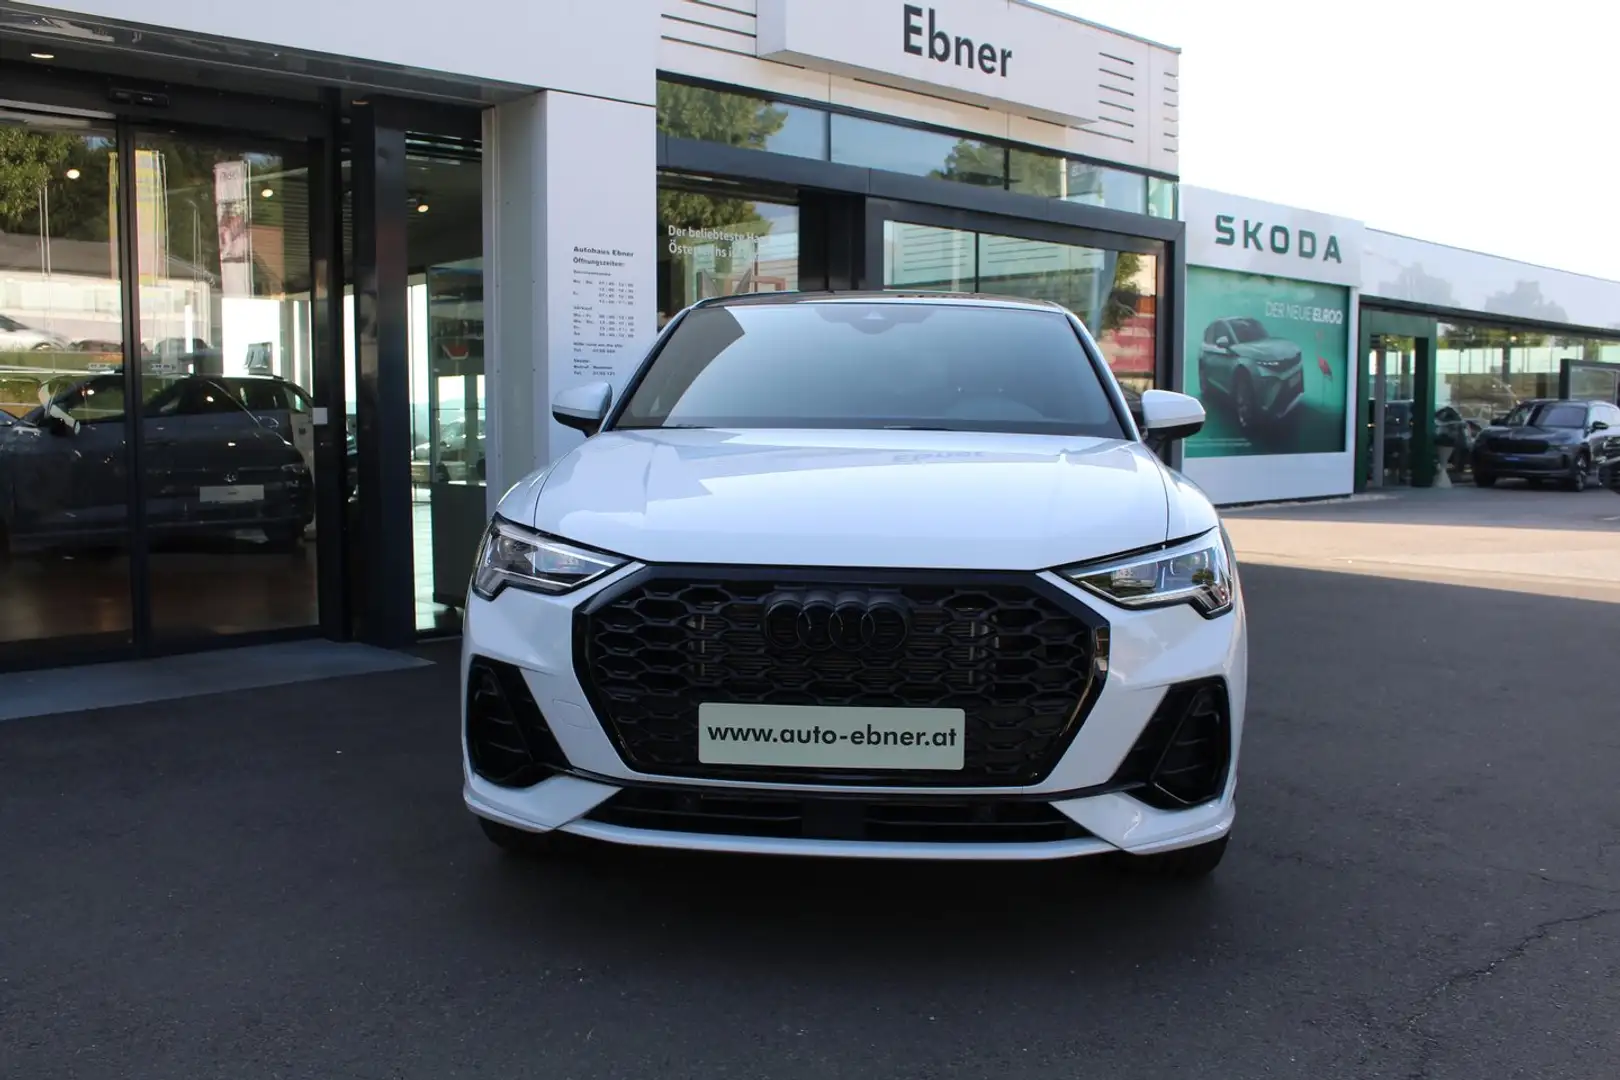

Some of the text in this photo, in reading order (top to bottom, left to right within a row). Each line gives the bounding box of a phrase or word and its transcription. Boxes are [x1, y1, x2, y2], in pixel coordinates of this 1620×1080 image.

[904, 3, 1012, 77] Ebner
[668, 225, 686, 237] Der
[688, 226, 745, 242] beliebteste
[573, 246, 634, 257] Autohaus Ebner
[1265, 301, 1285, 318] DER
[1286, 303, 1312, 321] NEUE
[707, 723, 958, 747] www.auto-ebner.at
